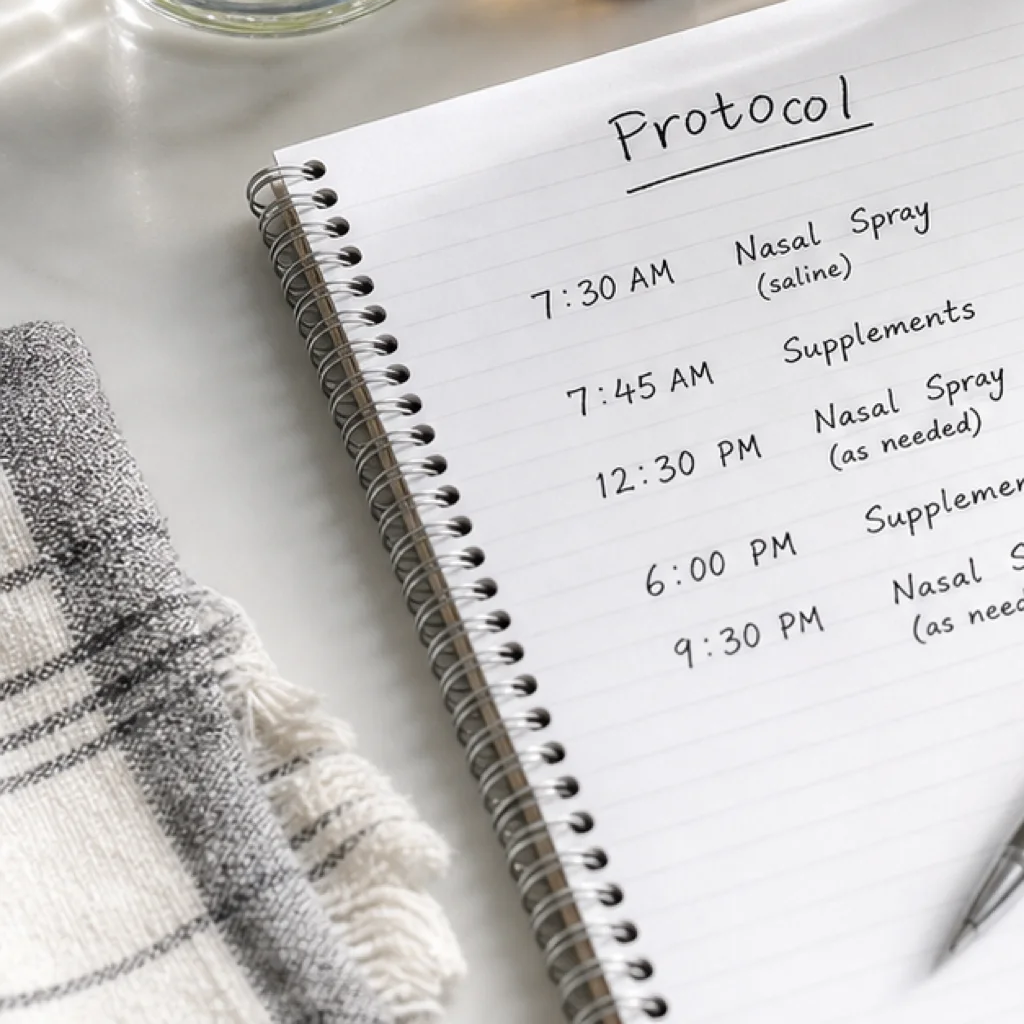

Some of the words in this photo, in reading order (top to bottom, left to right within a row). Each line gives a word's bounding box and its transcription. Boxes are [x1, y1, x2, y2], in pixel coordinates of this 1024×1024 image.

[607, 75, 852, 162] Protocol
[530, 275, 617, 320] 7:30
[630, 259, 675, 293] AM
[735, 221, 821, 266] Nasal
[850, 199, 931, 241] Spray
[757, 252, 852, 301] (saline)
[566, 371, 656, 416] 7:45
[670, 361, 715, 393] AM
[783, 299, 976, 367] Supplements
[597, 450, 695, 499] 12:30
[717, 434, 762, 468] PM
[814, 388, 899, 434] Nasal
[926, 366, 1005, 405] Spray
[829, 443, 869, 471] (as
[881, 407, 982, 453] needed)
[646, 551, 725, 597] 6:00
[750, 532, 797, 566] PM
[674, 623, 760, 668] 9:30
[778, 606, 824, 640] PM
[892, 557, 982, 605] Nasal
[913, 614, 954, 644] (as
